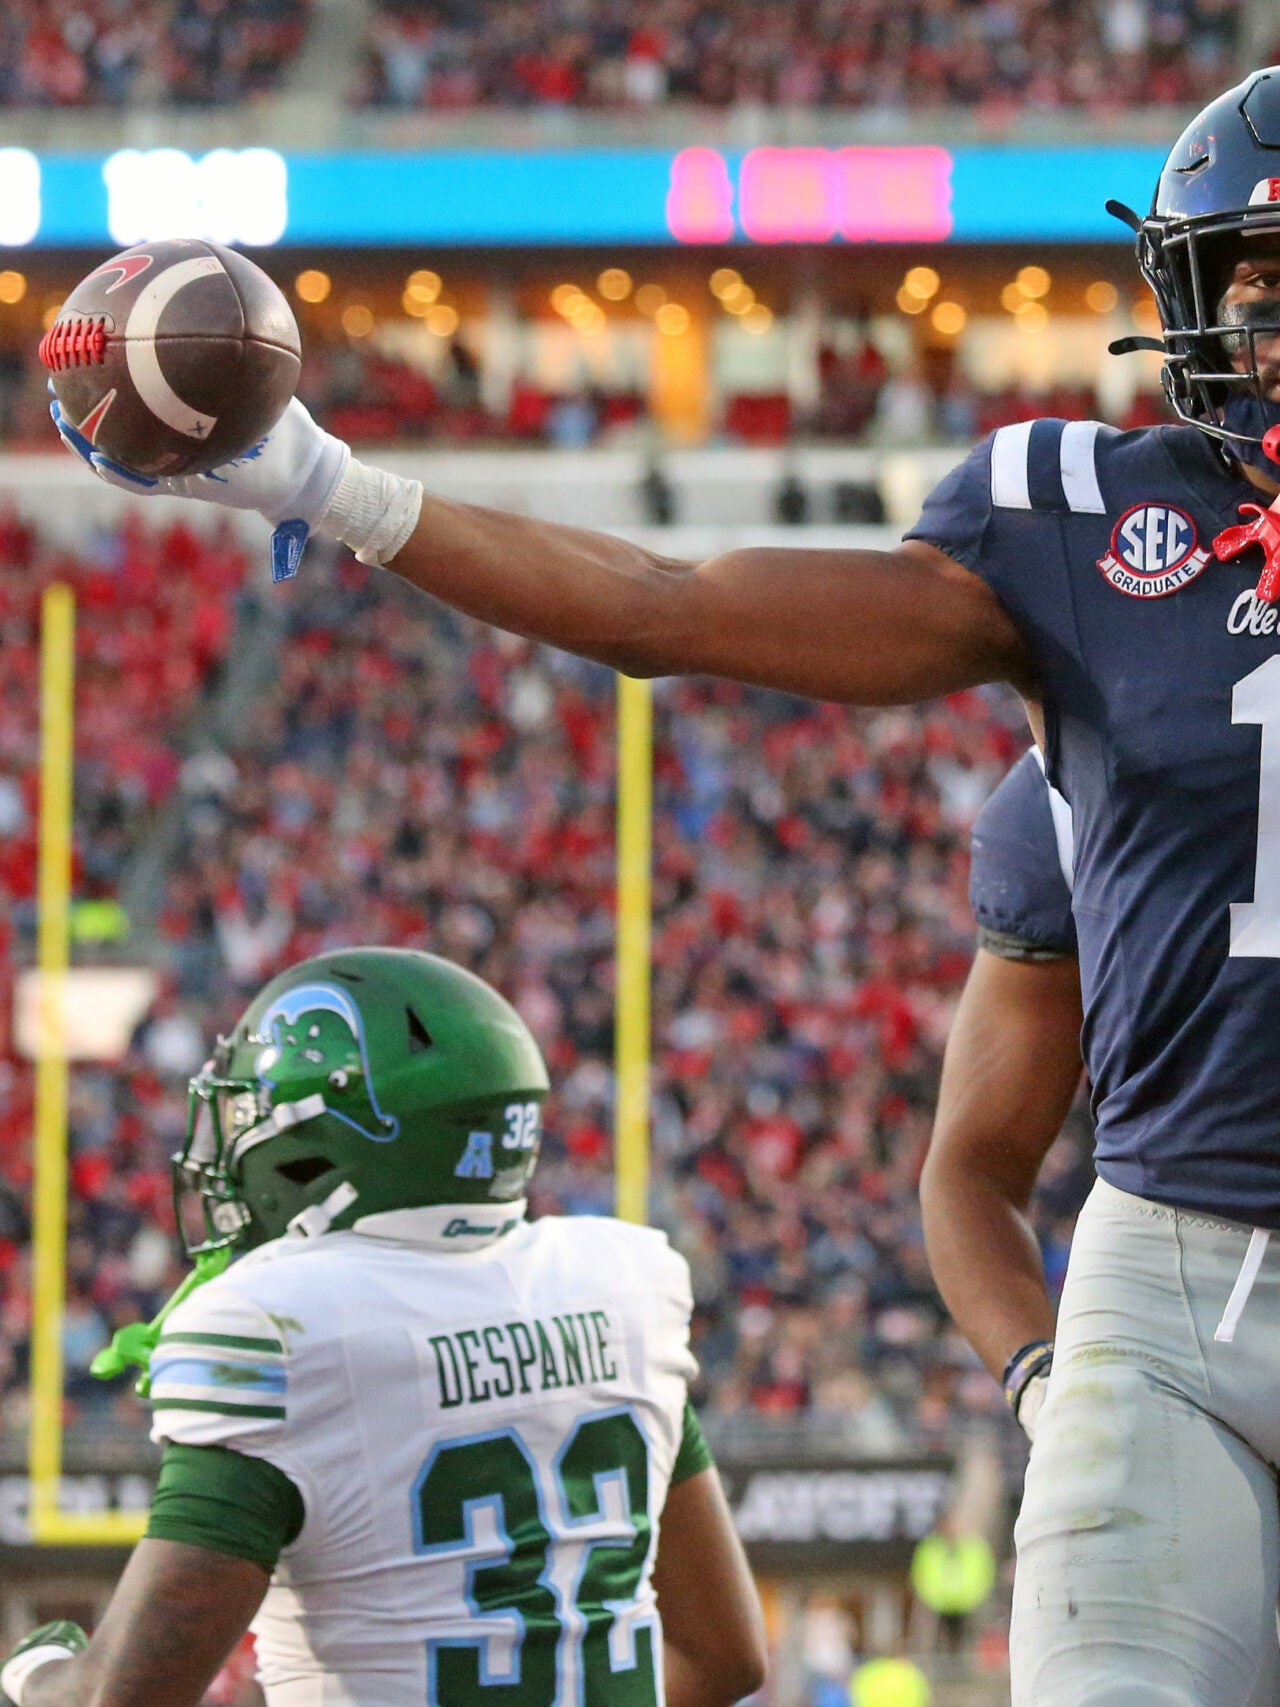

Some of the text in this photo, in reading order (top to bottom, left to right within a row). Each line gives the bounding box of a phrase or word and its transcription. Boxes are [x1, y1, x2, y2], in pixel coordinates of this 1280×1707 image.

[1120, 506, 1190, 572] SEC
[1112, 563, 1196, 595] GRADUATE
[1226, 588, 1279, 636] Ole
[502, 1102, 540, 1149] 32
[427, 1311, 618, 1409] DESPANIE
[409, 1403, 660, 1707] 32
